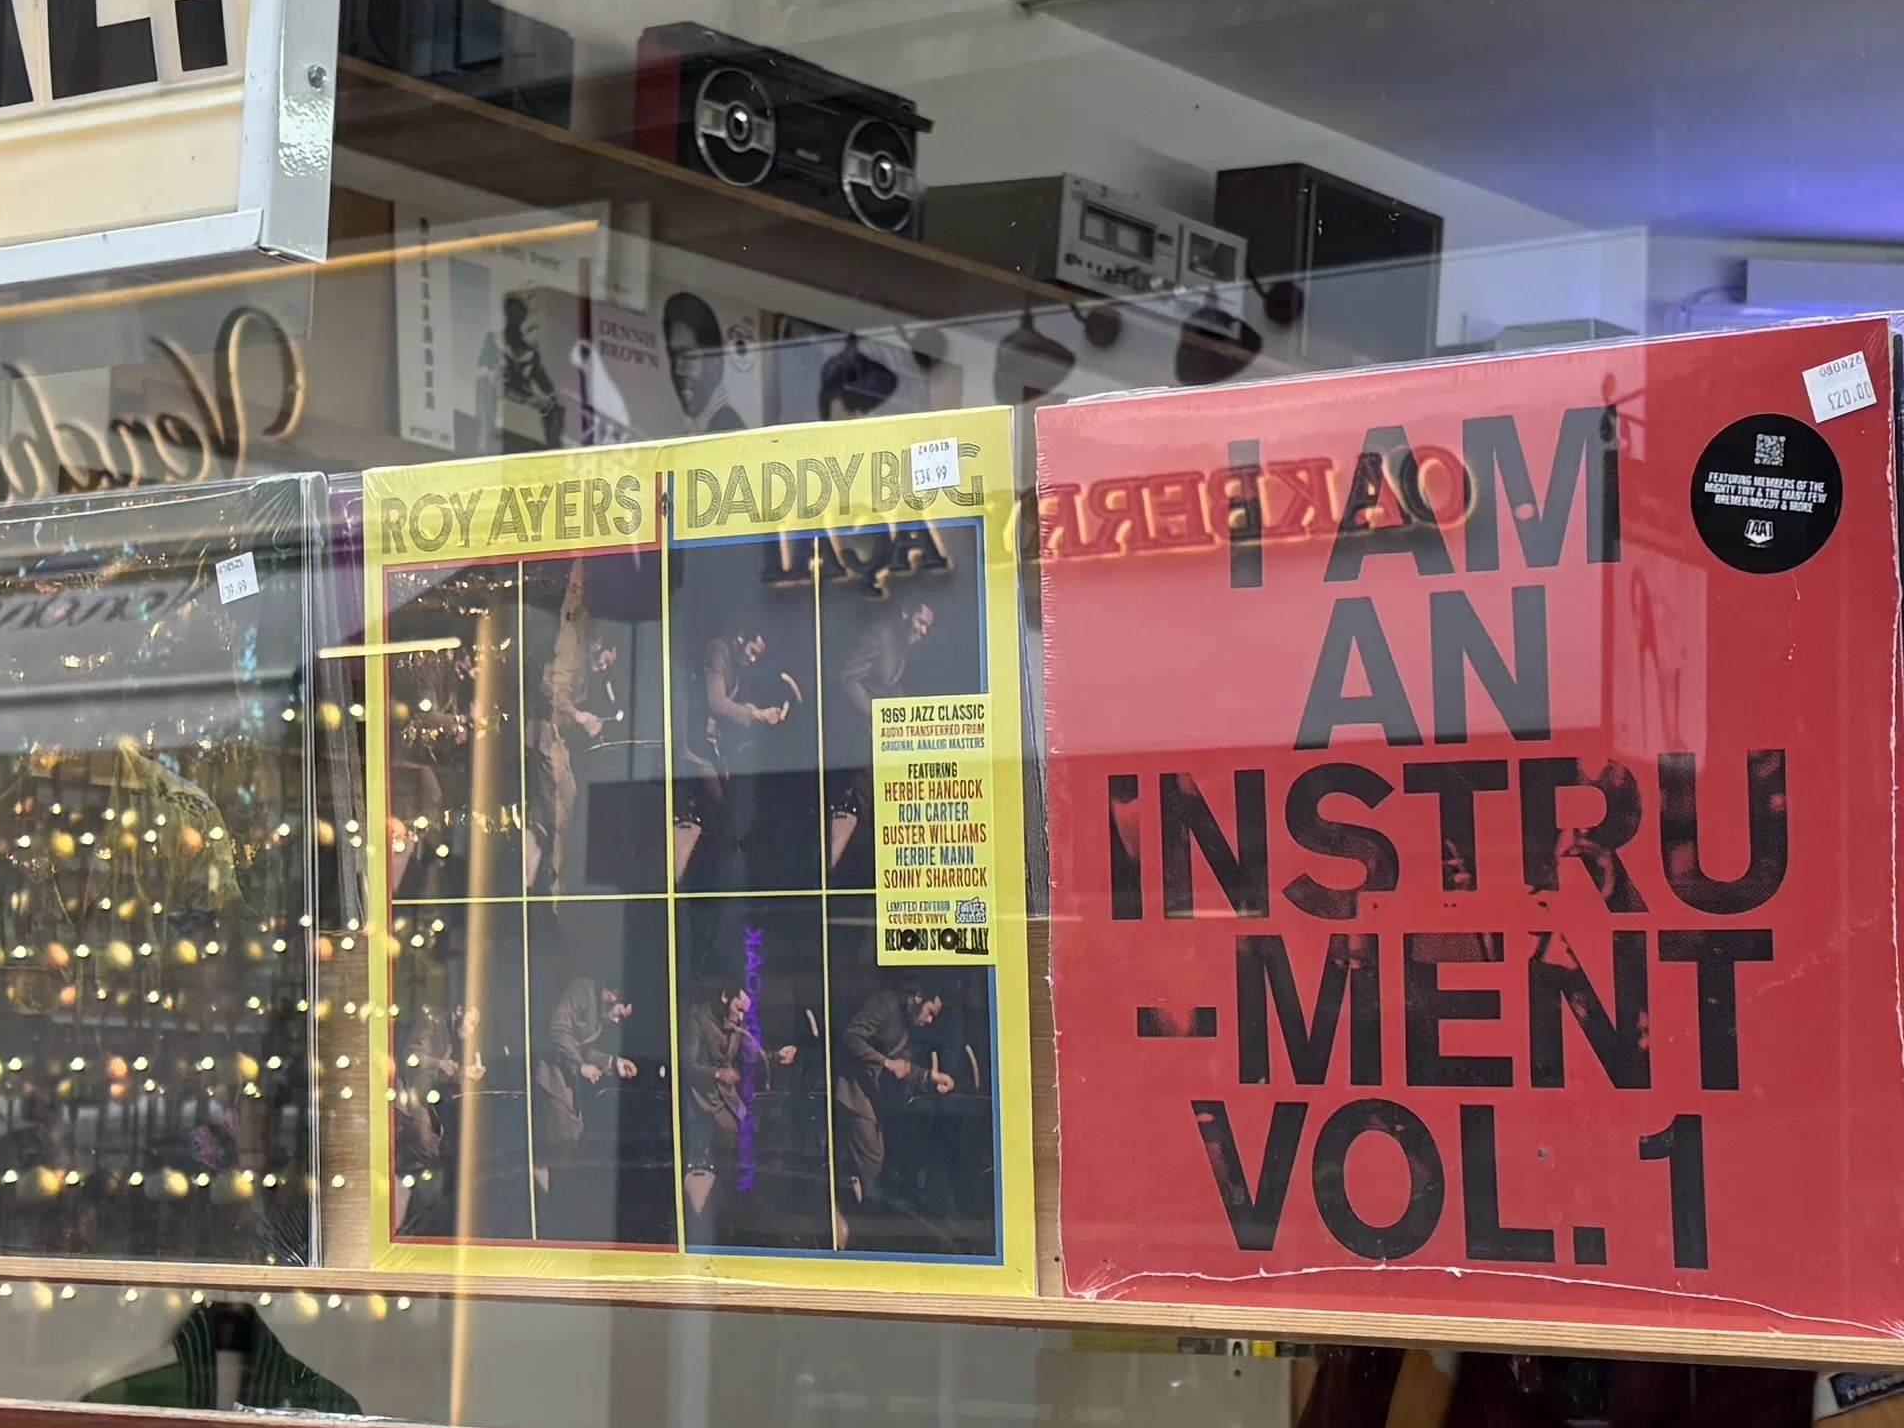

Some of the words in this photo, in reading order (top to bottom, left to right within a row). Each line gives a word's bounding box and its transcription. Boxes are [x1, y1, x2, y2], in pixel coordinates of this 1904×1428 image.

[1827, 380, 1873, 411] £20.00
[380, 486, 484, 555] ROY
[487, 474, 642, 545] AYERS
[687, 452, 865, 529] DADDY
[1226, 439, 1263, 588] I
[1321, 405, 1621, 582] AM
[1293, 585, 1552, 751] AN
[880, 707, 907, 723] 1969
[910, 705, 935, 722] JAZZ
[937, 703, 985, 721] CLASSIC
[907, 761, 958, 779] FEATURING
[884, 780, 924, 802] HERBIE
[928, 779, 983, 801] HANCOCK
[898, 802, 923, 823] RON
[925, 801, 969, 822] CARTER
[883, 825, 925, 846] BUSTER
[929, 823, 987, 844] WILLIAMS
[1106, 747, 1788, 922] INSTRU
[895, 847, 936, 867] HERBIE
[940, 846, 974, 865] MANN
[884, 869, 922, 889] SONNY
[926, 867, 987, 888] SHARROCK
